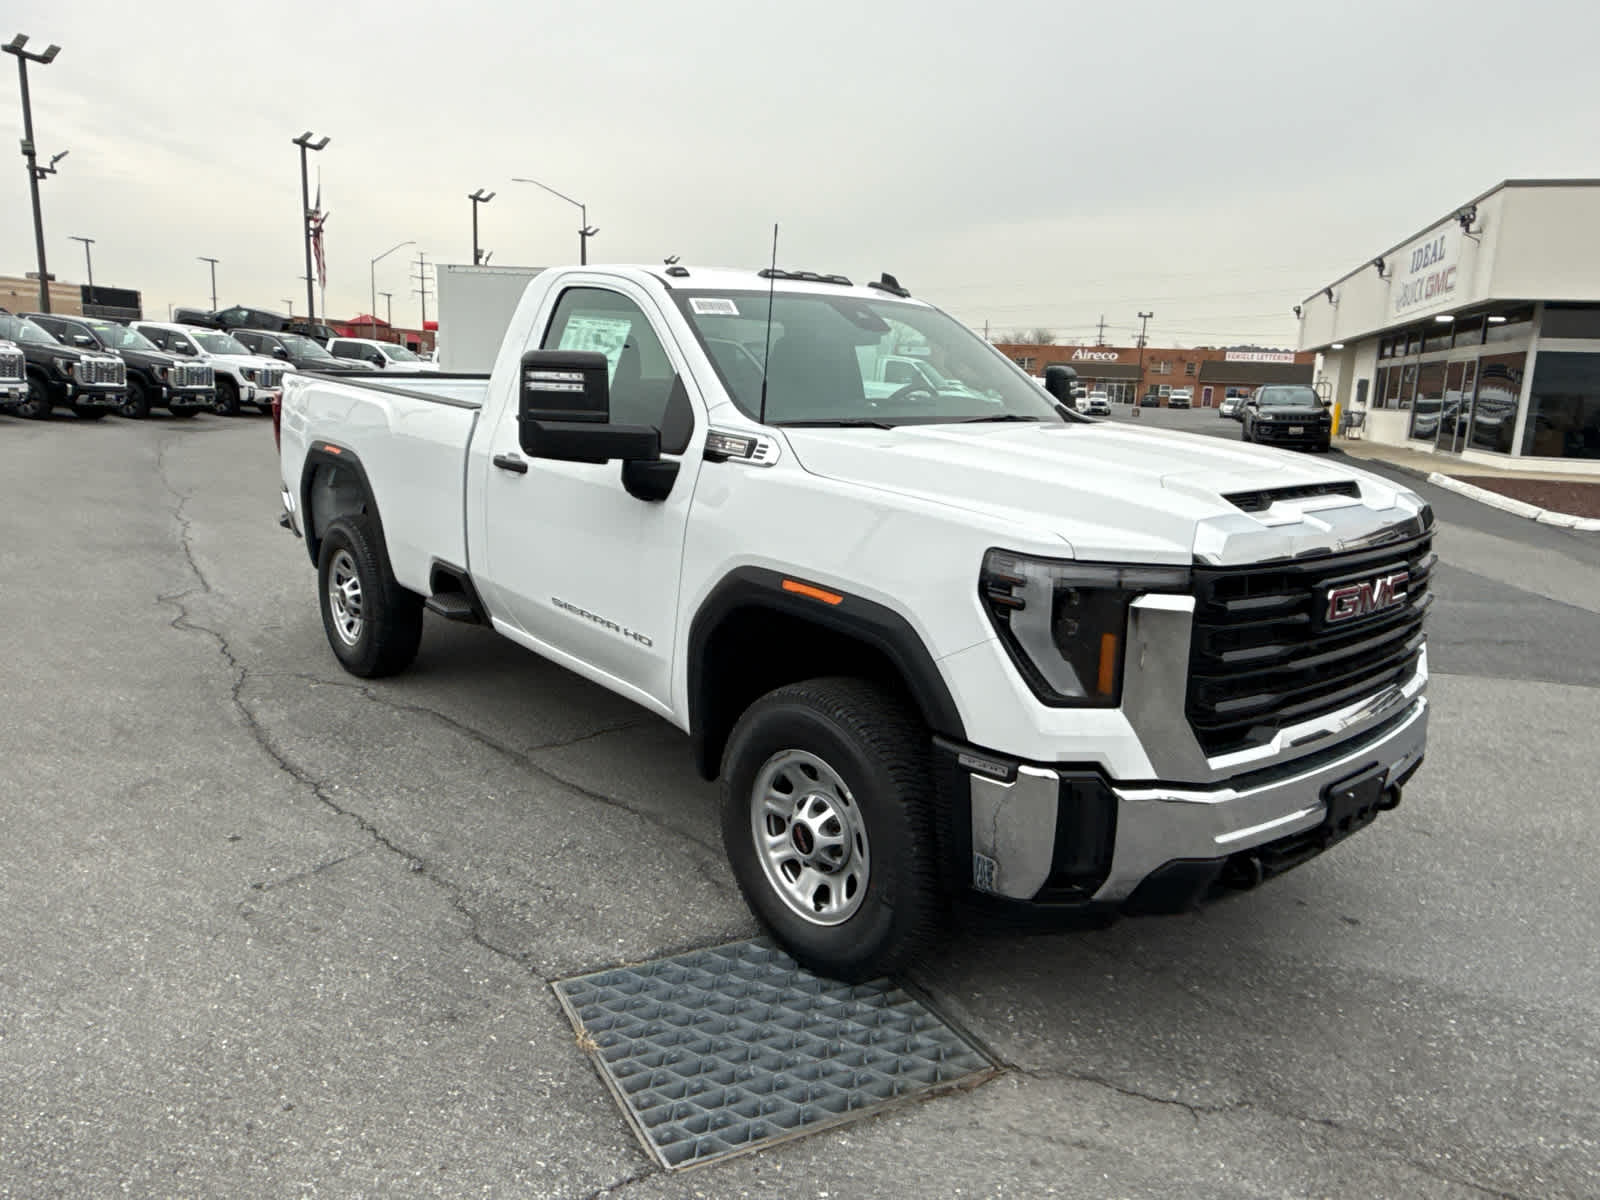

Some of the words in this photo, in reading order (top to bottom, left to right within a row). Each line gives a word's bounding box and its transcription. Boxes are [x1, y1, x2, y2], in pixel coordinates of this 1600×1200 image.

[1410, 234, 1446, 275] IDEAL
[1425, 266, 1457, 299] GMC
[1071, 348, 1119, 361] Aireco
[1227, 352, 1255, 361] VEHICLE
[1256, 353, 1295, 362] LETTERING
[1325, 572, 1408, 622] GMC
[551, 597, 620, 633] SIERRA
[623, 628, 653, 647] HD
